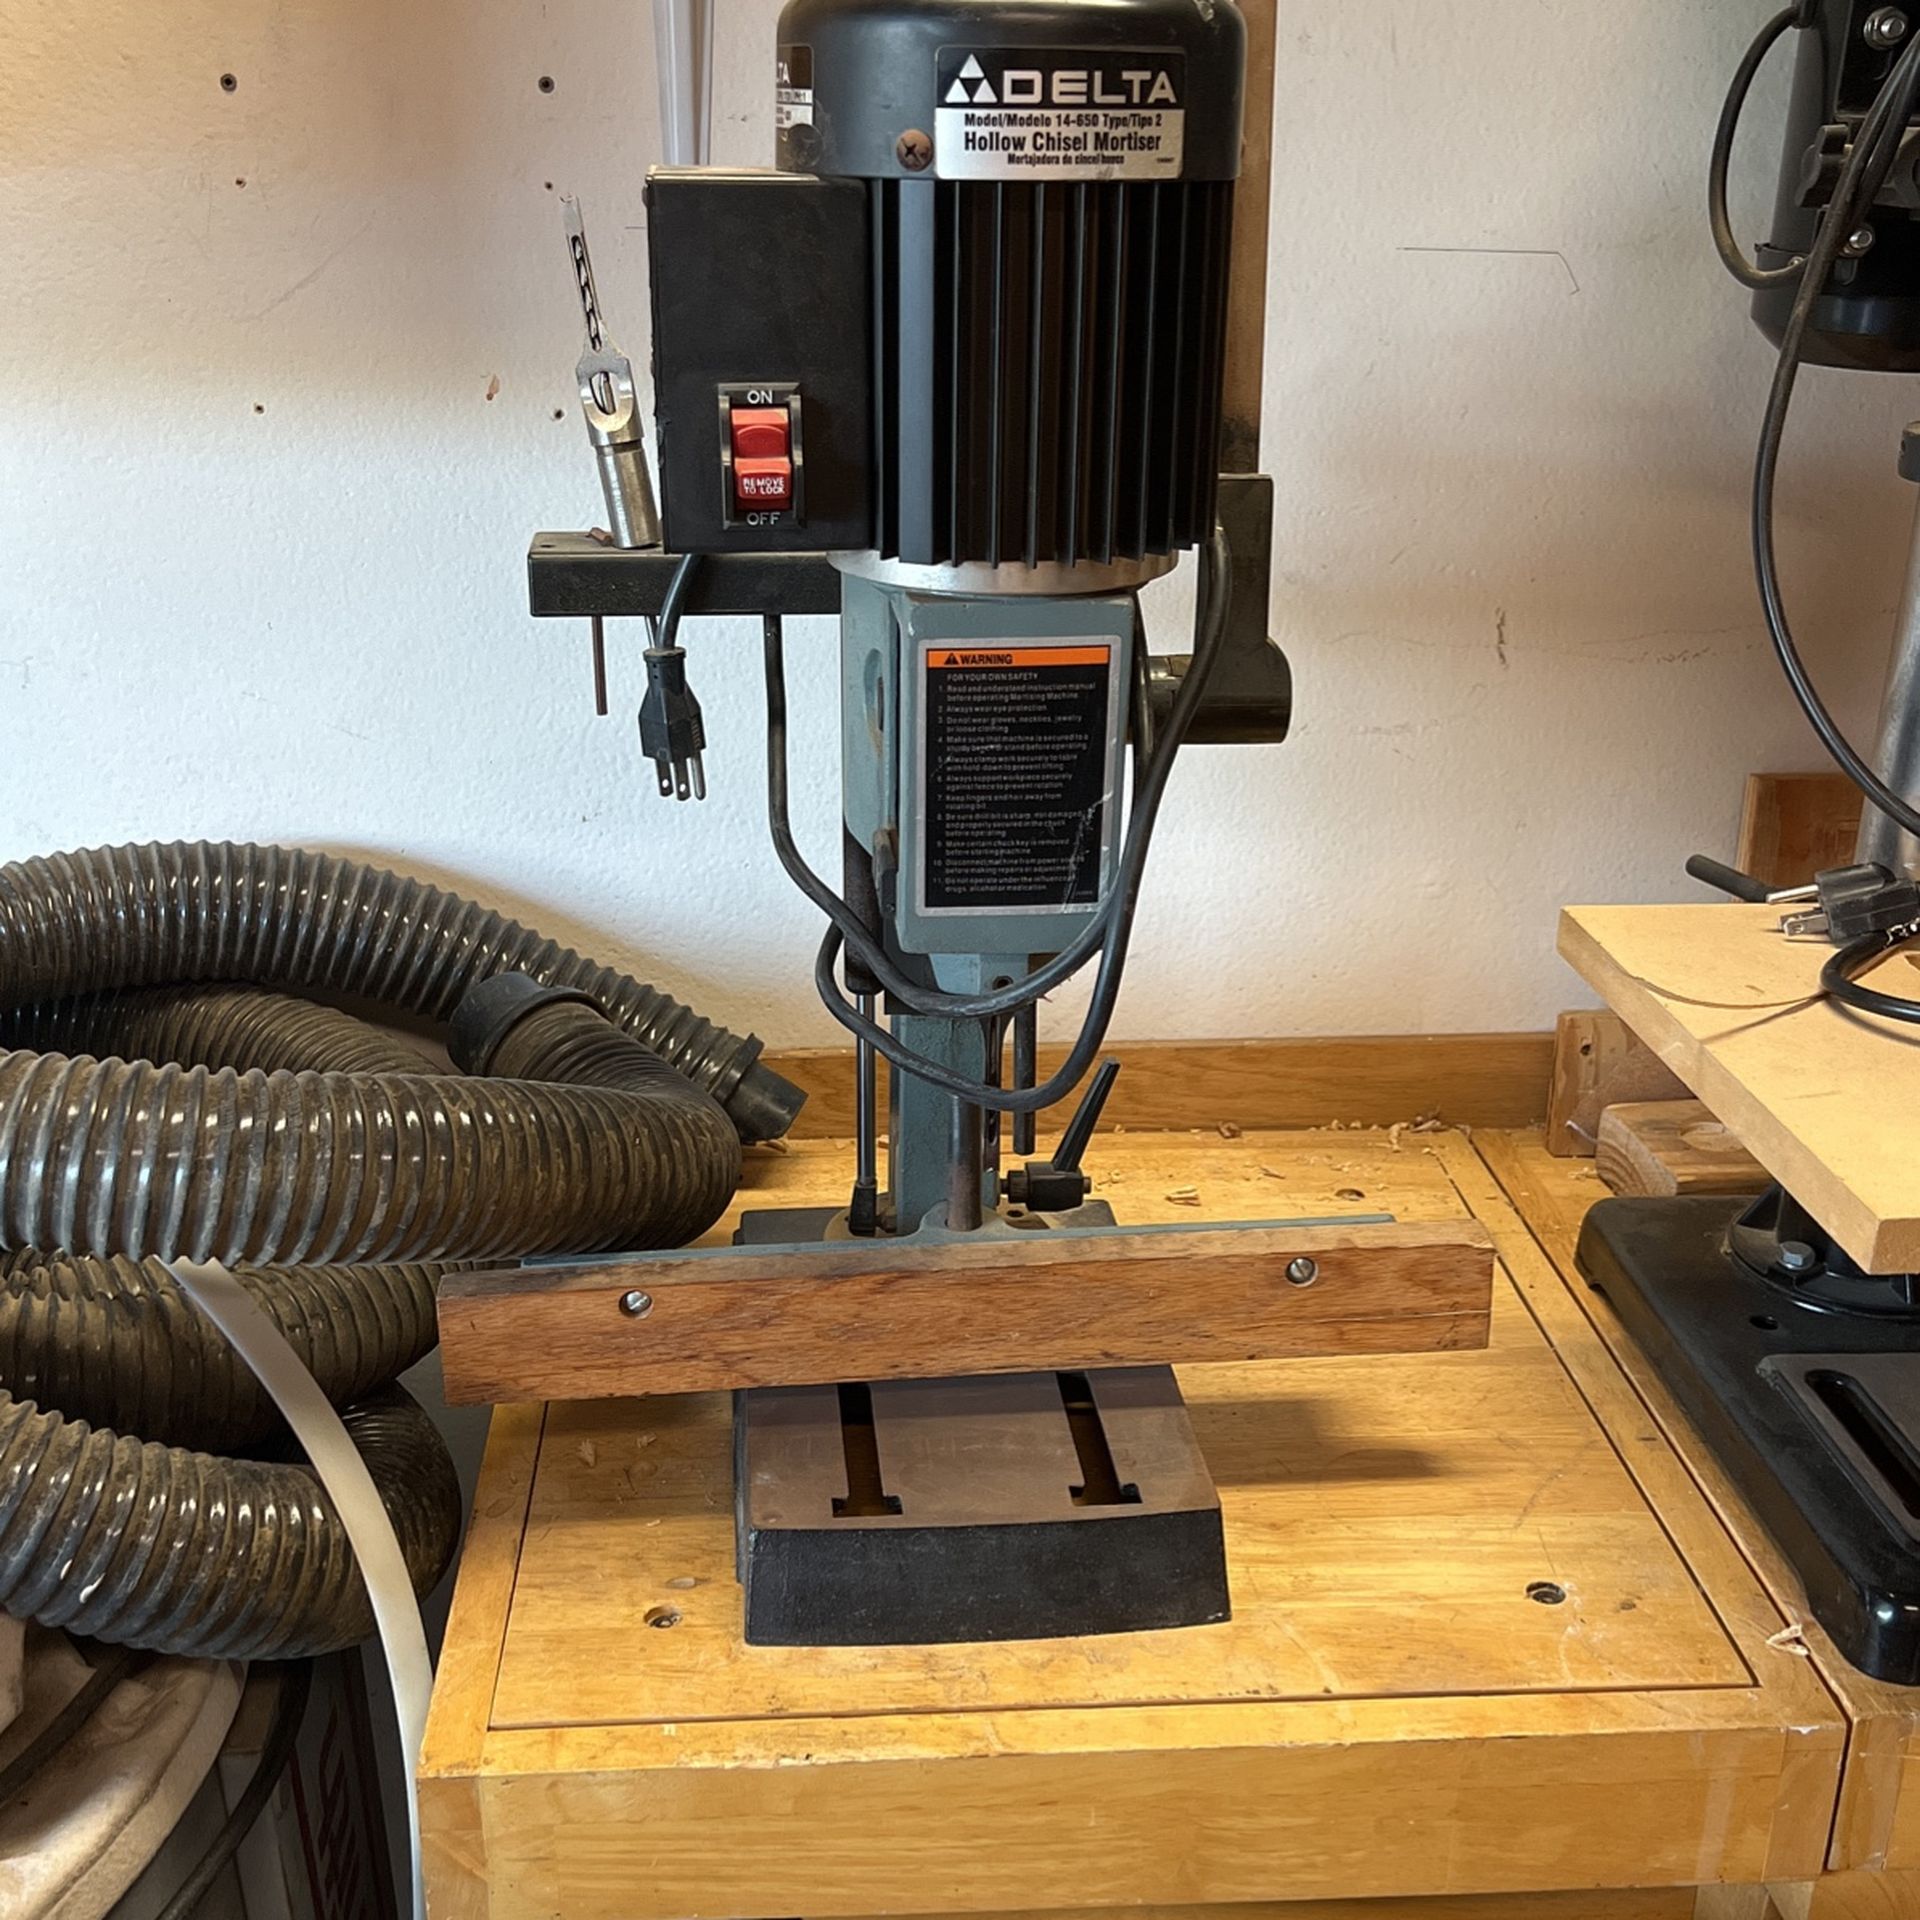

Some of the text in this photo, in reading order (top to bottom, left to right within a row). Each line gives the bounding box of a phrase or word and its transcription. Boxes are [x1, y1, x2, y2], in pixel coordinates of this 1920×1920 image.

[1003, 70, 1177, 104] DELTA
[964, 113, 1162, 130] Model/Modelo 14-650 Type/Tipo 2
[964, 131, 1162, 151] Hollow Chisel Mortiser
[747, 390, 773, 404] ON
[743, 477, 785, 487] REMOVE
[745, 486, 785, 494] TO LOCK
[747, 512, 780, 525] OFF
[960, 654, 1013, 664] WARNING
